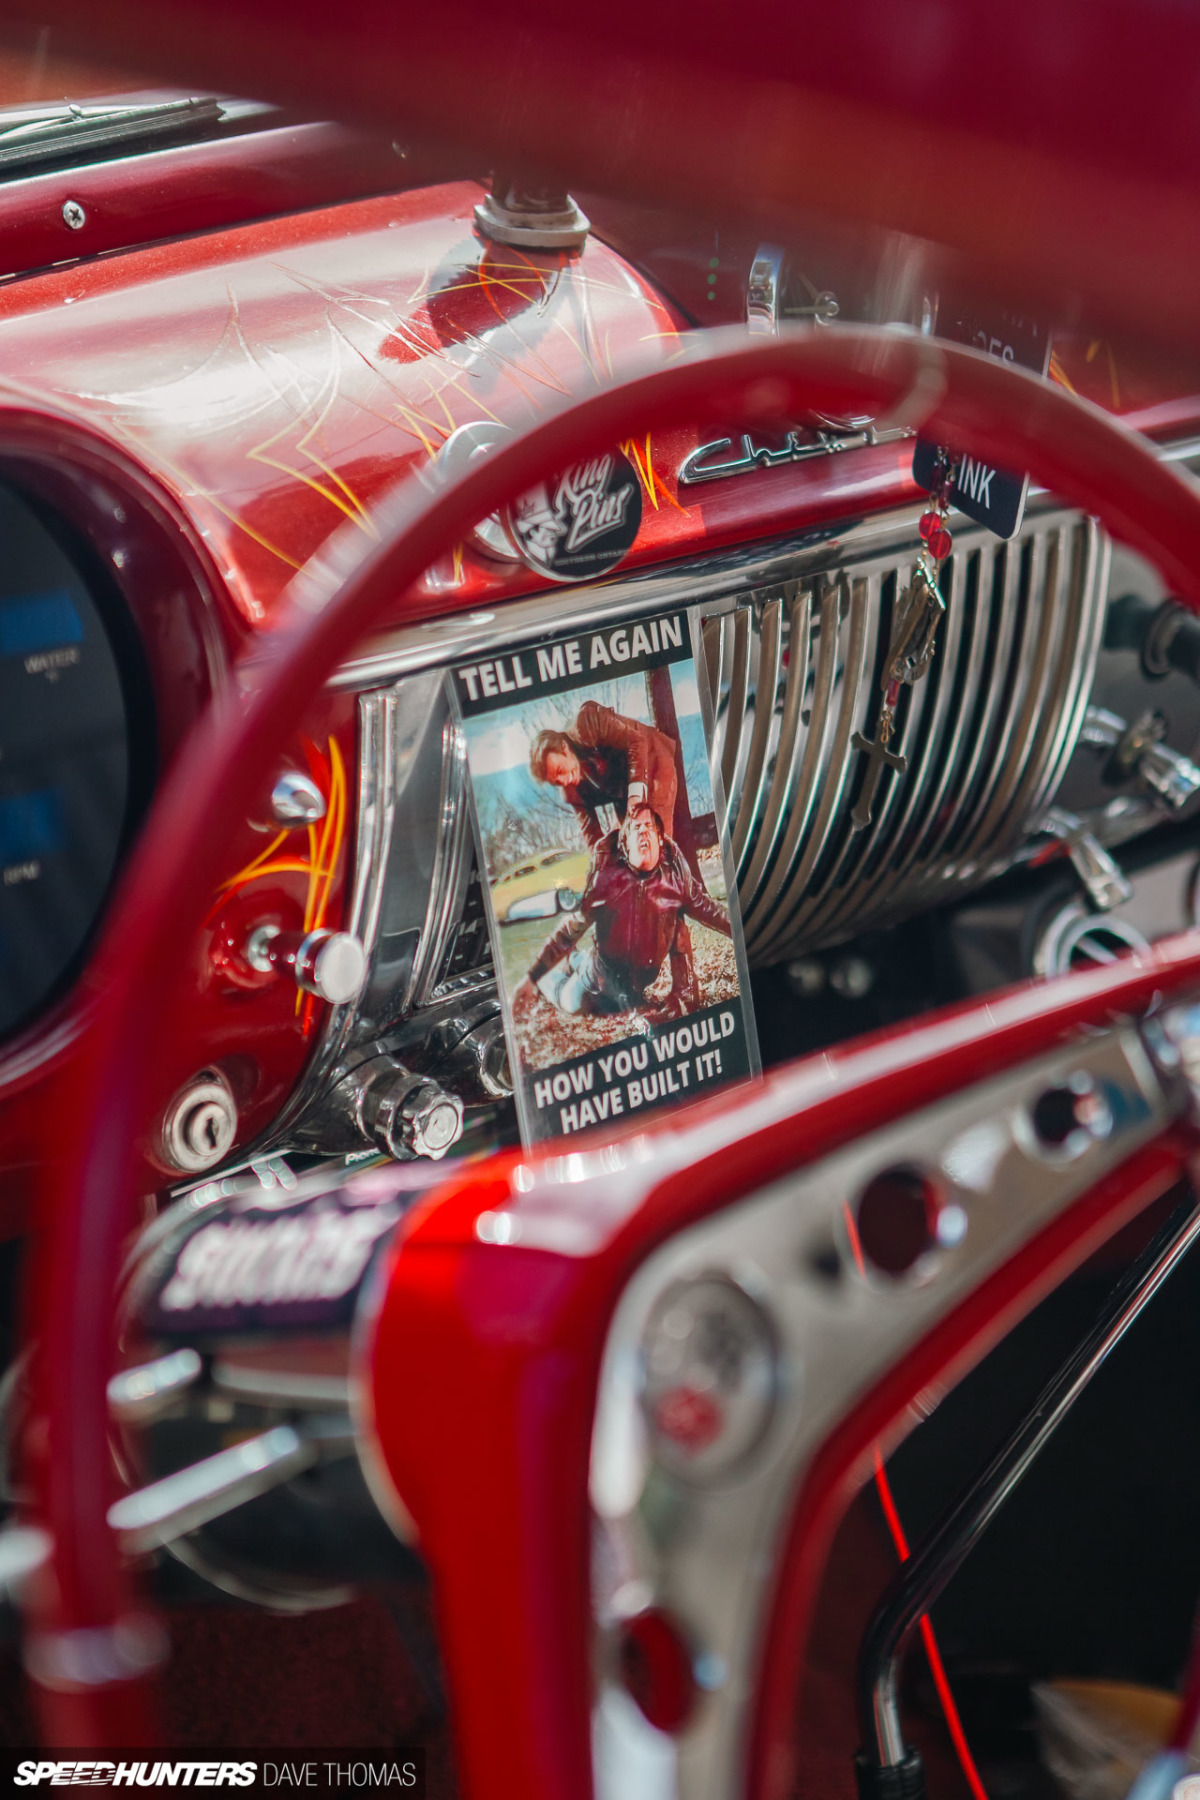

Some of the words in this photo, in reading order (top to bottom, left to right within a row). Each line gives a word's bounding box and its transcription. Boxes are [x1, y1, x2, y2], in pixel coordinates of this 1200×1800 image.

[555, 453, 613, 519] King
[566, 484, 632, 551] Pins
[24, 648, 80, 674] WATER
[459, 656, 531, 701] TELL
[537, 641, 582, 682] ME
[590, 616, 683, 670] AGAIN
[534, 1063, 594, 1109] HOW
[598, 1042, 649, 1083] YOU
[652, 1011, 735, 1063] WOULD
[560, 1087, 624, 1135] HAVE
[627, 1061, 690, 1109] BUILT
[695, 1049, 723, 1081] IT!
